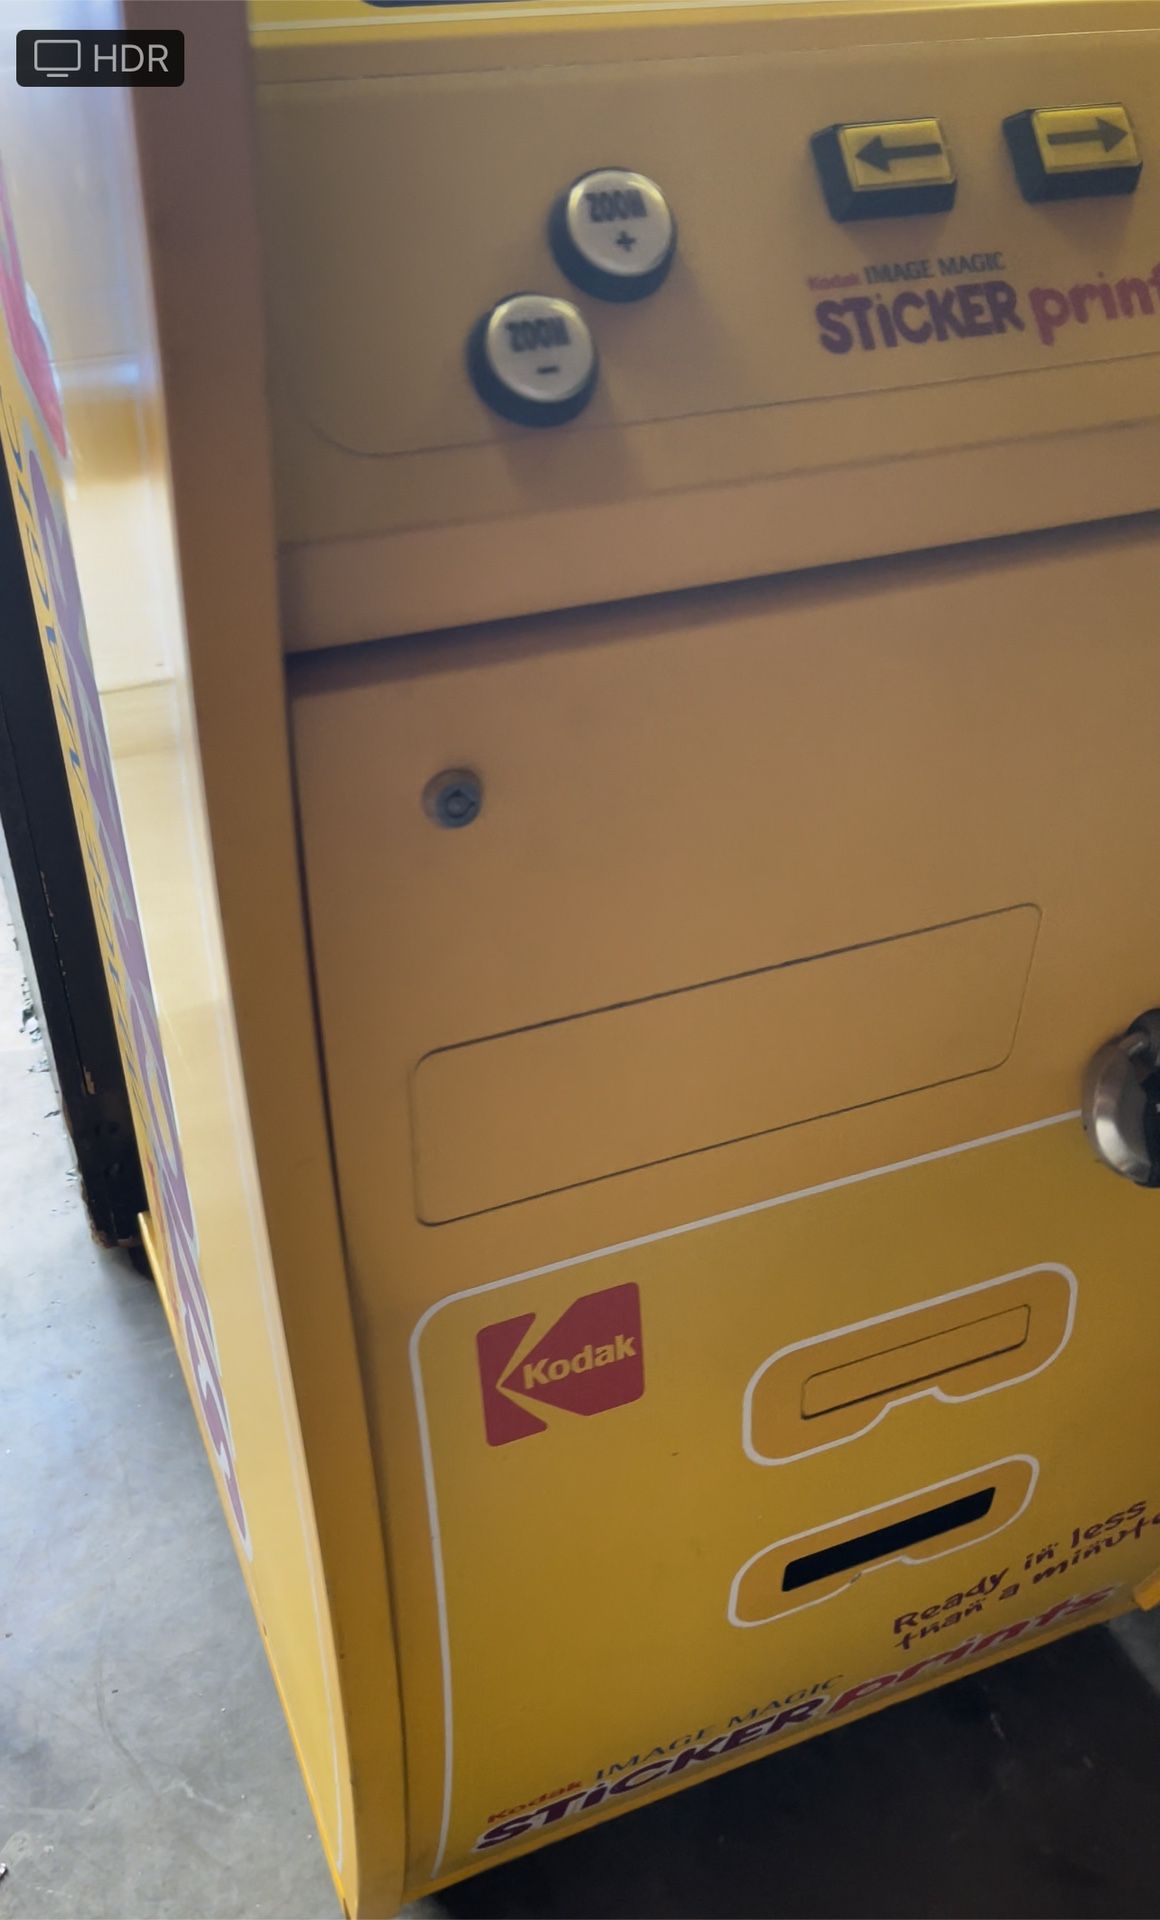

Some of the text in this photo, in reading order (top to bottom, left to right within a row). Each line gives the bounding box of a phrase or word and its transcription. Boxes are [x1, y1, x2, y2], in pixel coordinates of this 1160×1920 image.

[585, 189, 648, 223] ZOOM
[864, 260, 935, 284] IMAGE
[937, 252, 1006, 275] MAGIC
[522, 1334, 637, 1390] Kodak
[893, 1500, 1146, 1634] Ready in less
[827, 1584, 1120, 1714] prints
[894, 1597, 986, 1650] than
[998, 1583, 1020, 1601] a
[487, 1674, 844, 1823] Kodak IMAGE MAGIC
